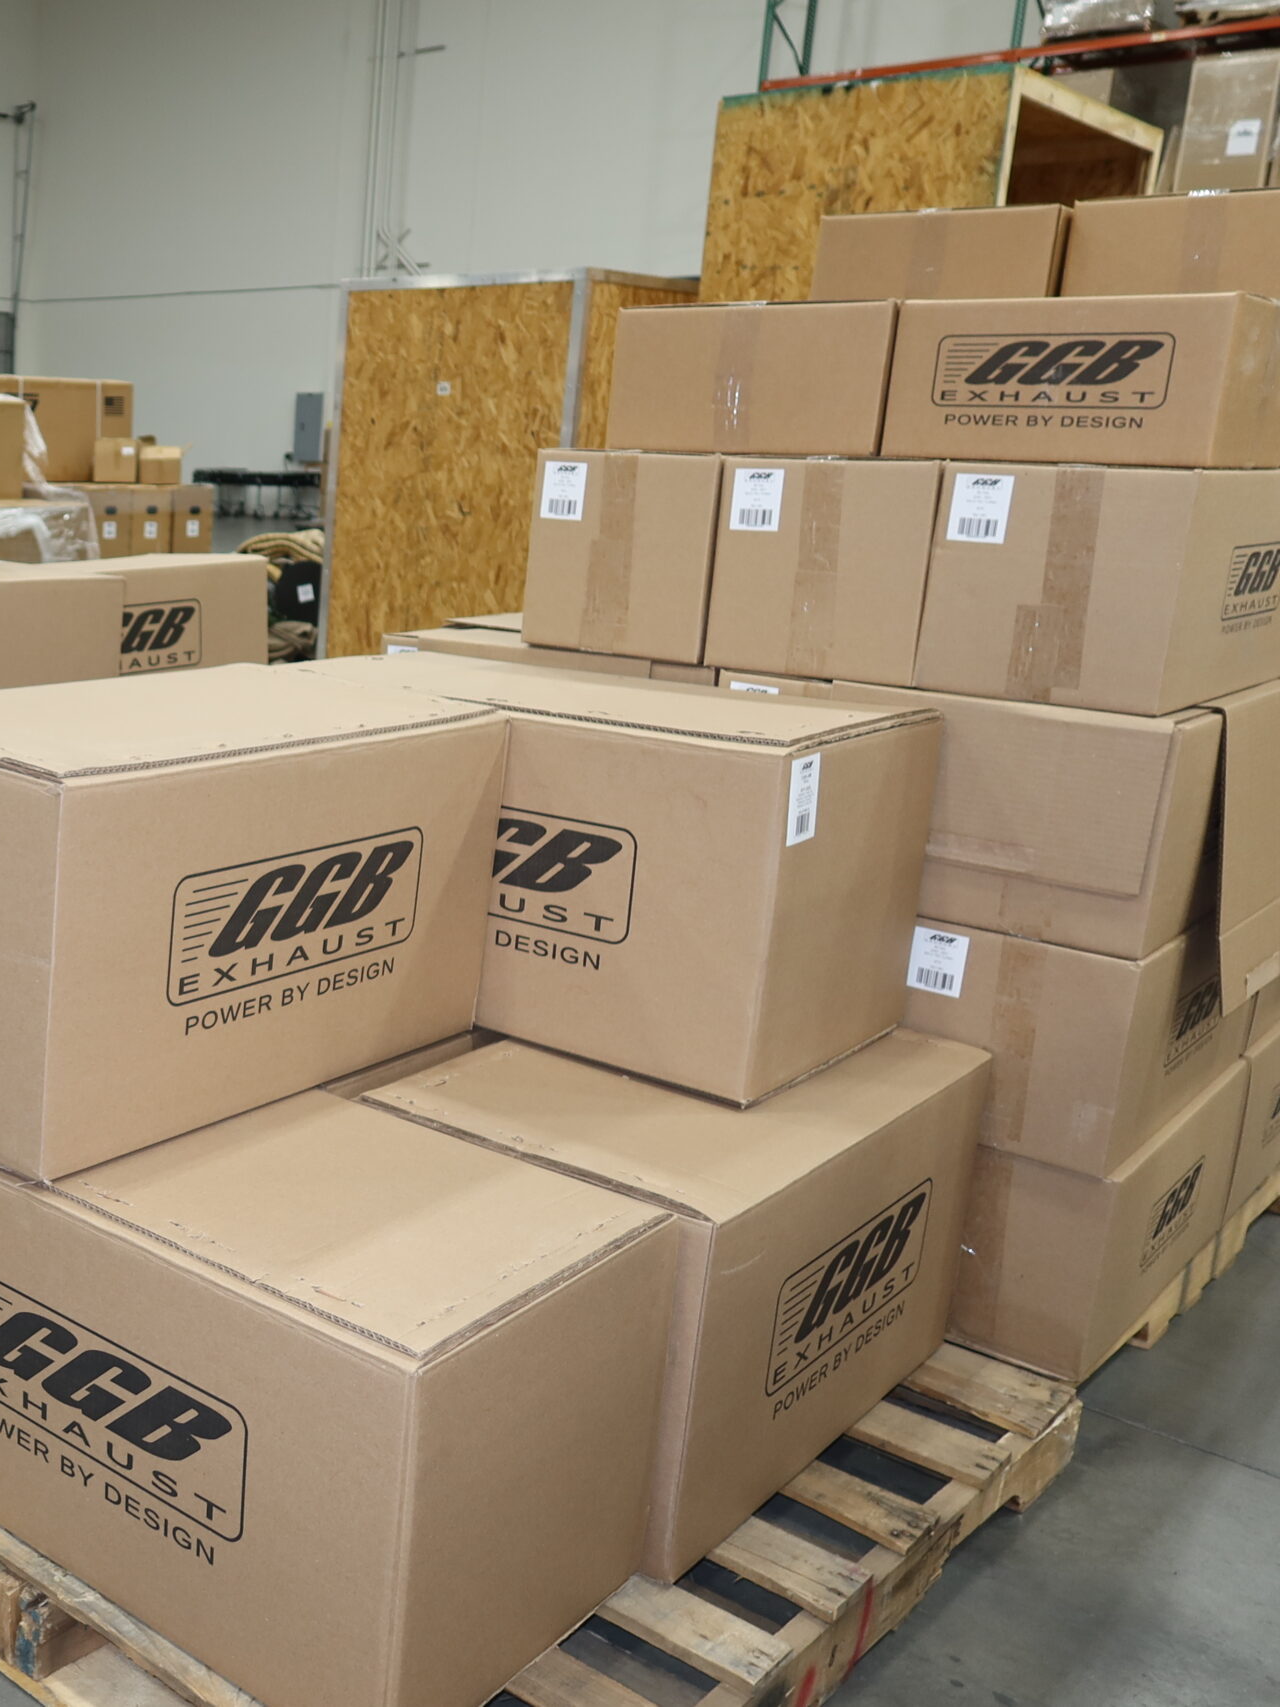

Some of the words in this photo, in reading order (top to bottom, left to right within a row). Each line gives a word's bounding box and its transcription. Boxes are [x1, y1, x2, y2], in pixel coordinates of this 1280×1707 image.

[964, 340, 1165, 386] GGB
[940, 389, 1156, 404] EXHAUST
[944, 413, 1018, 427] POWER
[1026, 415, 1053, 428] BY
[1061, 415, 1144, 429] DESIGN
[1234, 548, 1280, 597] GGB
[1223, 595, 1278, 616] EXHAUST
[121, 606, 195, 655] GB
[119, 650, 195, 670] AUST
[208, 840, 414, 959] GGB
[178, 918, 406, 996] EXHAUST
[494, 929, 600, 971] DESIGN
[184, 994, 271, 1036] POWER
[280, 982, 311, 1008] BY
[316, 957, 394, 996] DESIGN
[793, 1191, 927, 1344] GGB
[772, 1261, 915, 1386] EXHAUST
[772, 1361, 828, 1421] POWER
[832, 1347, 851, 1372] BY
[854, 1300, 906, 1354] DESIGN
[60, 1454, 95, 1488] BY
[104, 1480, 216, 1566] DESIGN
